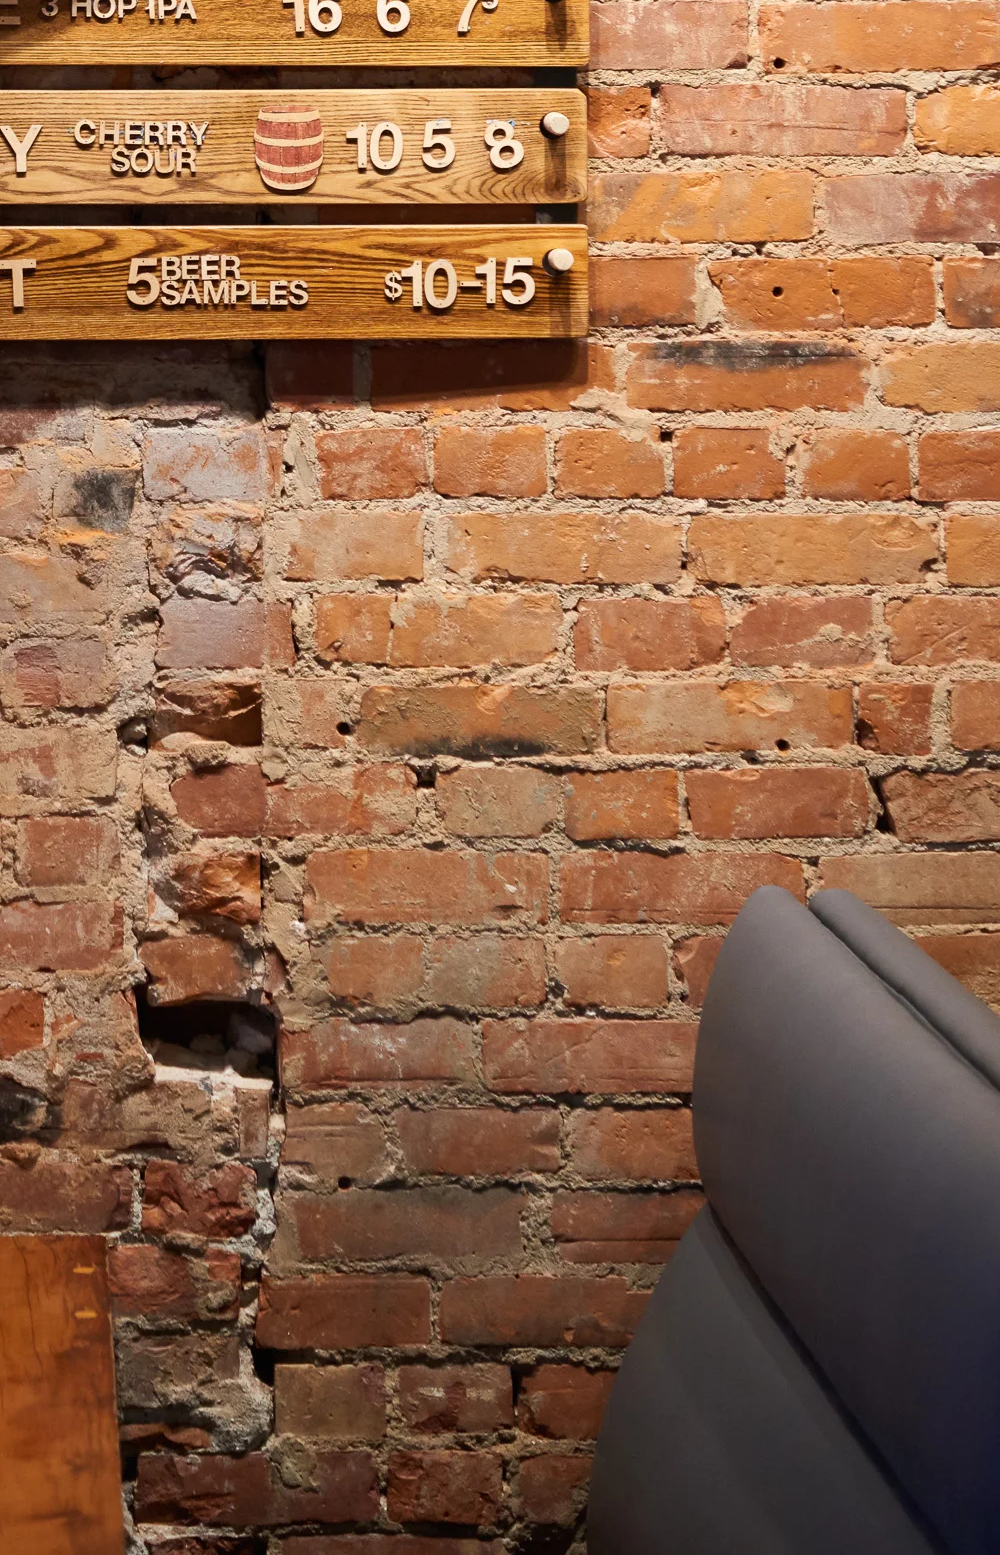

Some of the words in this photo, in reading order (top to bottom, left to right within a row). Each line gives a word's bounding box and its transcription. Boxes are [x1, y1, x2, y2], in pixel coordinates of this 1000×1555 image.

[72, 120, 210, 147] CHERRY
[346, 120, 404, 170] 10
[422, 120, 456, 170] 5
[484, 119, 525, 170] 8
[110, 146, 198, 175] SOUR
[126, 257, 160, 307] 5
[161, 254, 241, 281] BEER
[160, 279, 309, 307] SAMPLES
[384, 256, 536, 310] $10-15
